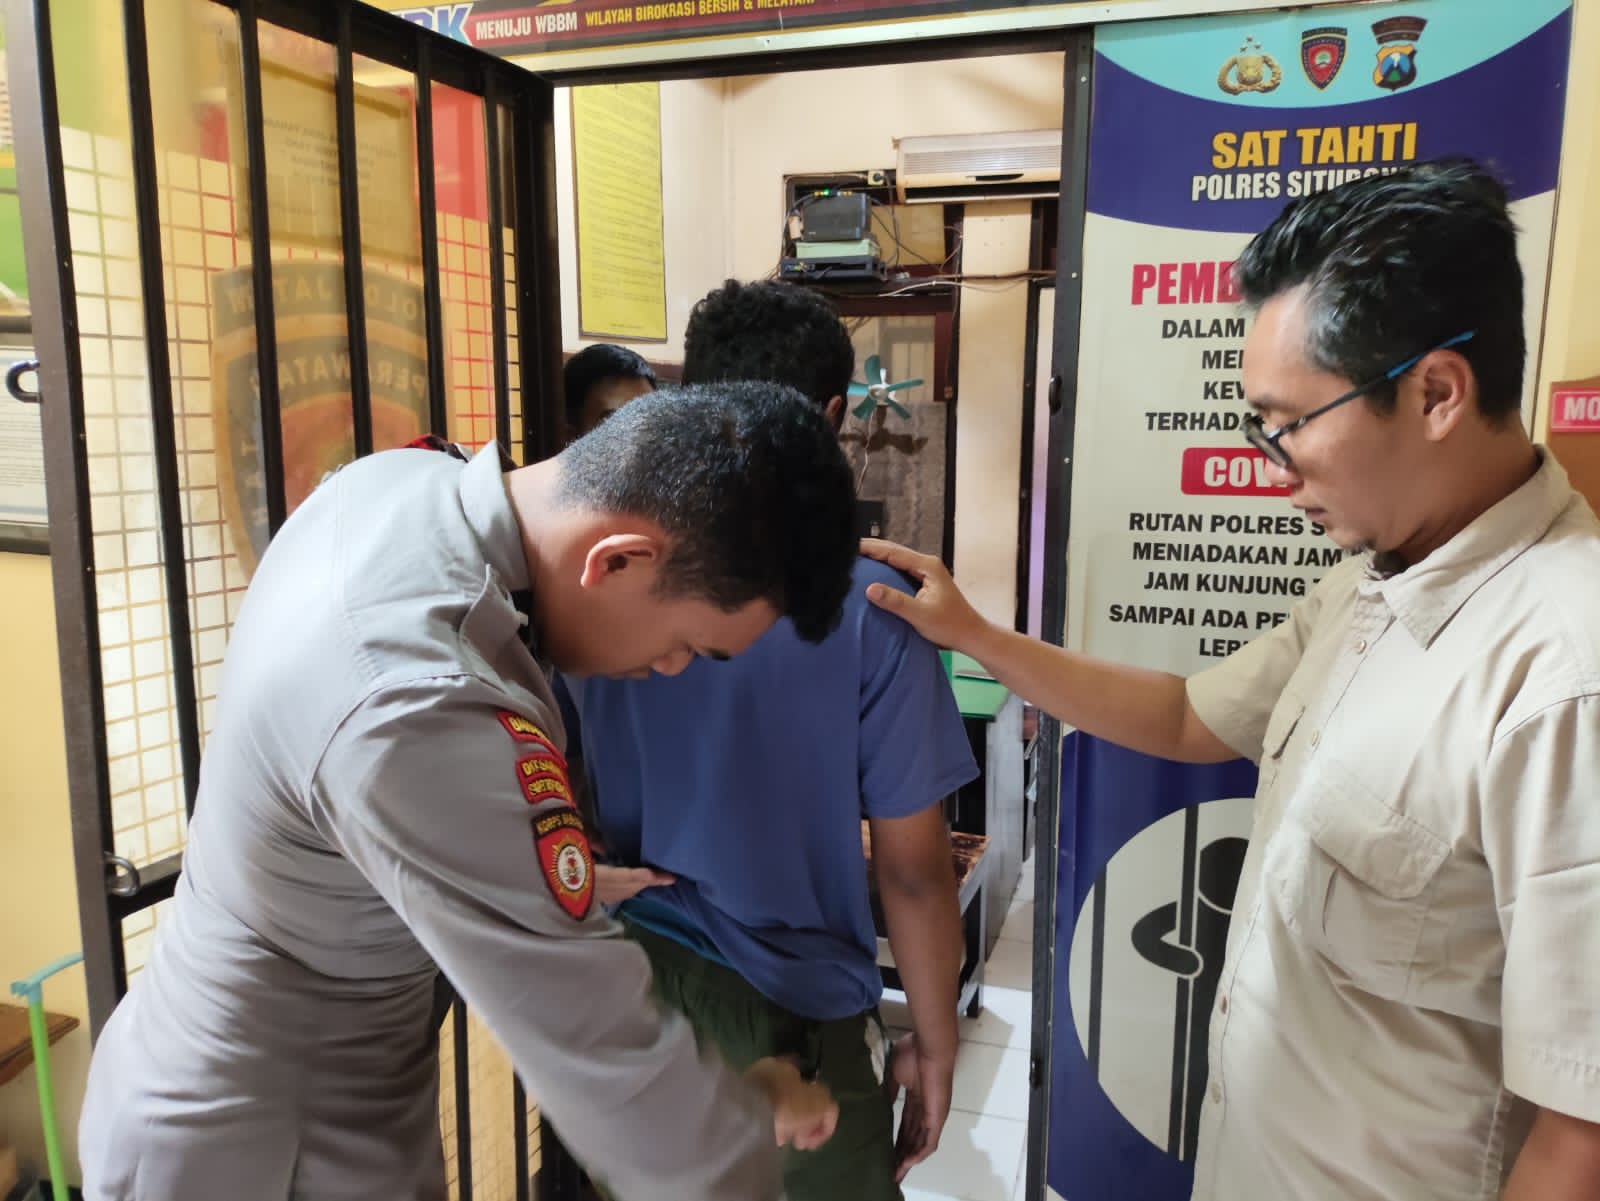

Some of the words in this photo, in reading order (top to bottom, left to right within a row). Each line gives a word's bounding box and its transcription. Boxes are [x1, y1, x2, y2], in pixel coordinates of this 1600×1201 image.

[476, 16, 531, 41] MENUJU
[535, 12, 577, 34] WBBM
[585, 8, 632, 26] WILAYAH
[635, 3, 695, 23] BIROKRASI
[698, 0, 740, 15] BERSIH
[1212, 130, 1287, 169] SAT
[1297, 122, 1417, 165] TAHTI
[1192, 171, 1280, 201] POLRES
[1161, 318, 1246, 339] DALAM
[1204, 456, 1287, 488] COV
[1129, 512, 1203, 532] RUTAN
[1210, 514, 1304, 536] POLRES
[1132, 542, 1288, 566] MENIADAKAN
[1294, 547, 1343, 567] JAM
[1143, 571, 1189, 592] JAM
[1196, 573, 1305, 597] KUNJUNG
[1108, 604, 1195, 627] SAMPAI
[1201, 608, 1248, 629] ADA
[1255, 611, 1290, 630] PE
